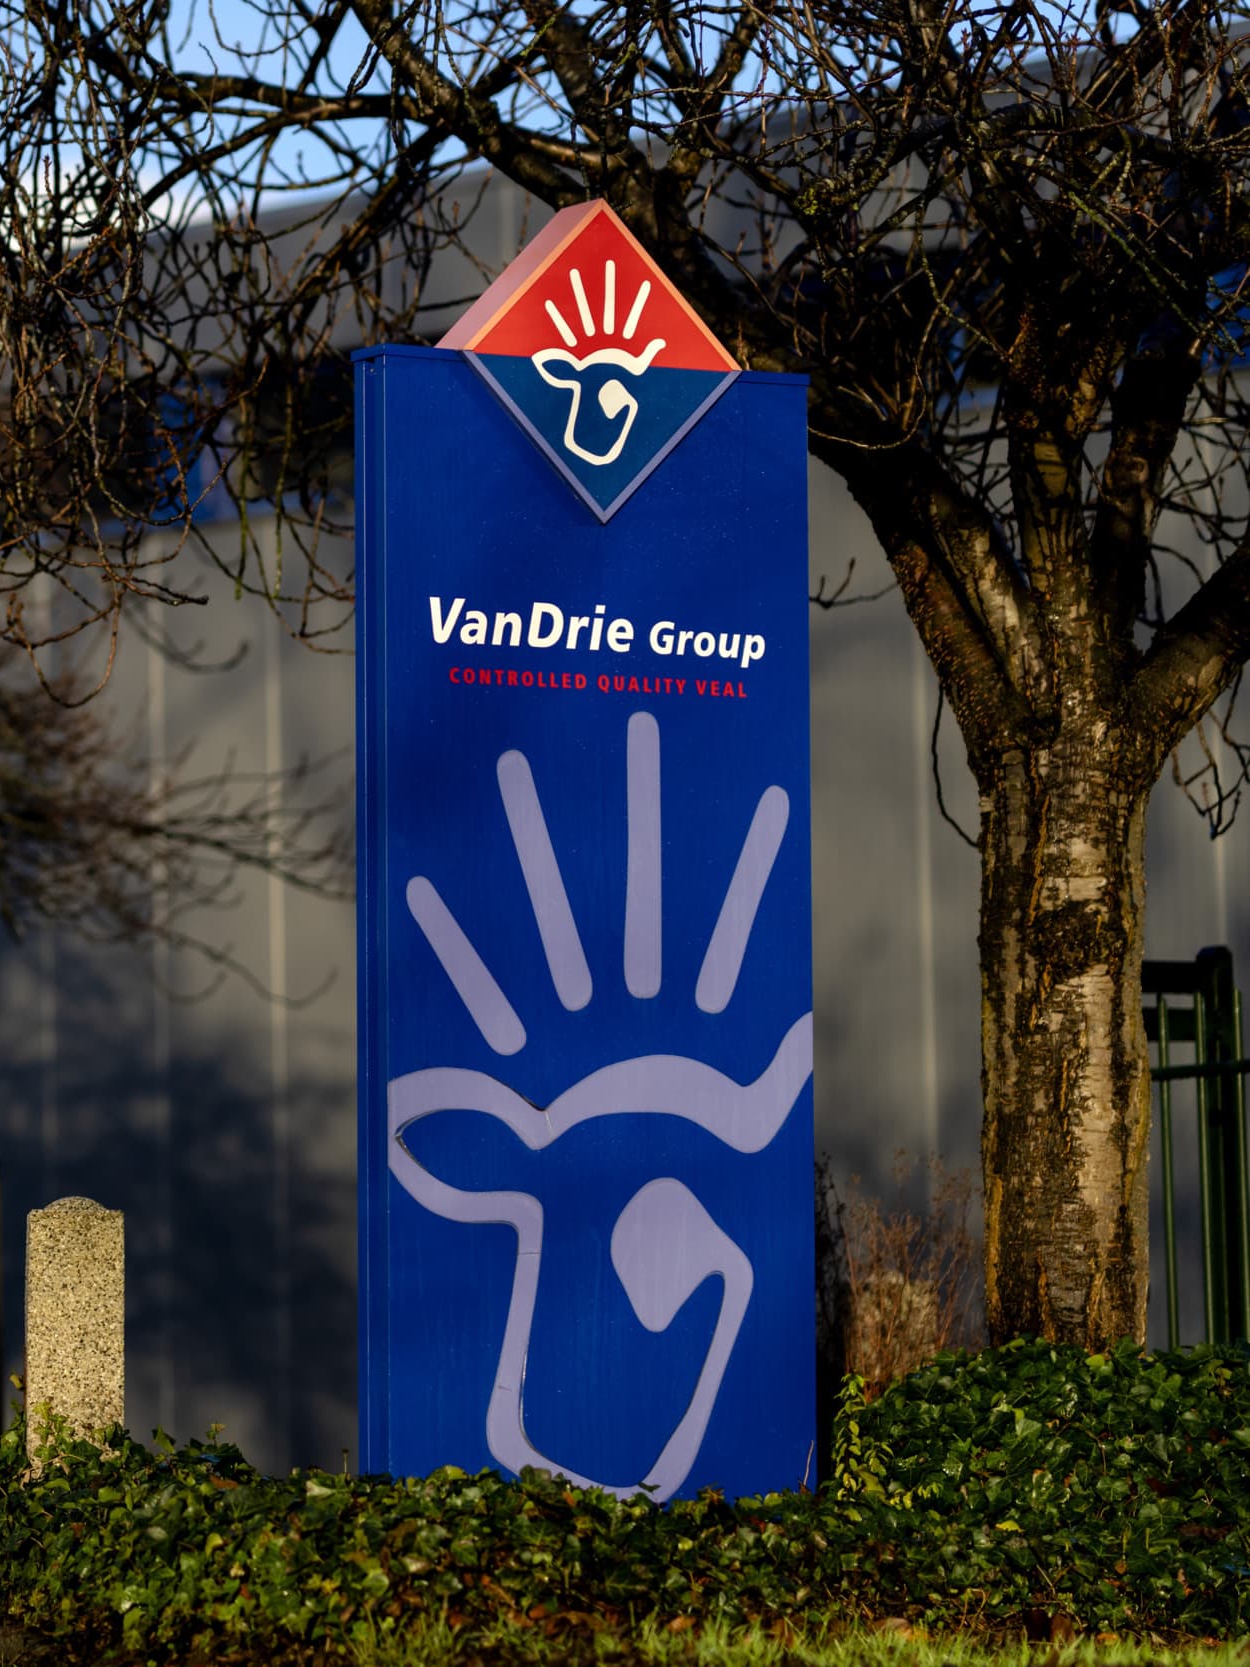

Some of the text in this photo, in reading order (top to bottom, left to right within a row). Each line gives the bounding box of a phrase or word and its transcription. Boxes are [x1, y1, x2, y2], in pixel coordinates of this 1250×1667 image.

[429, 596, 766, 669] VanDrie Group
[449, 667, 748, 699] CONTROLLED QUALITY VEAL
